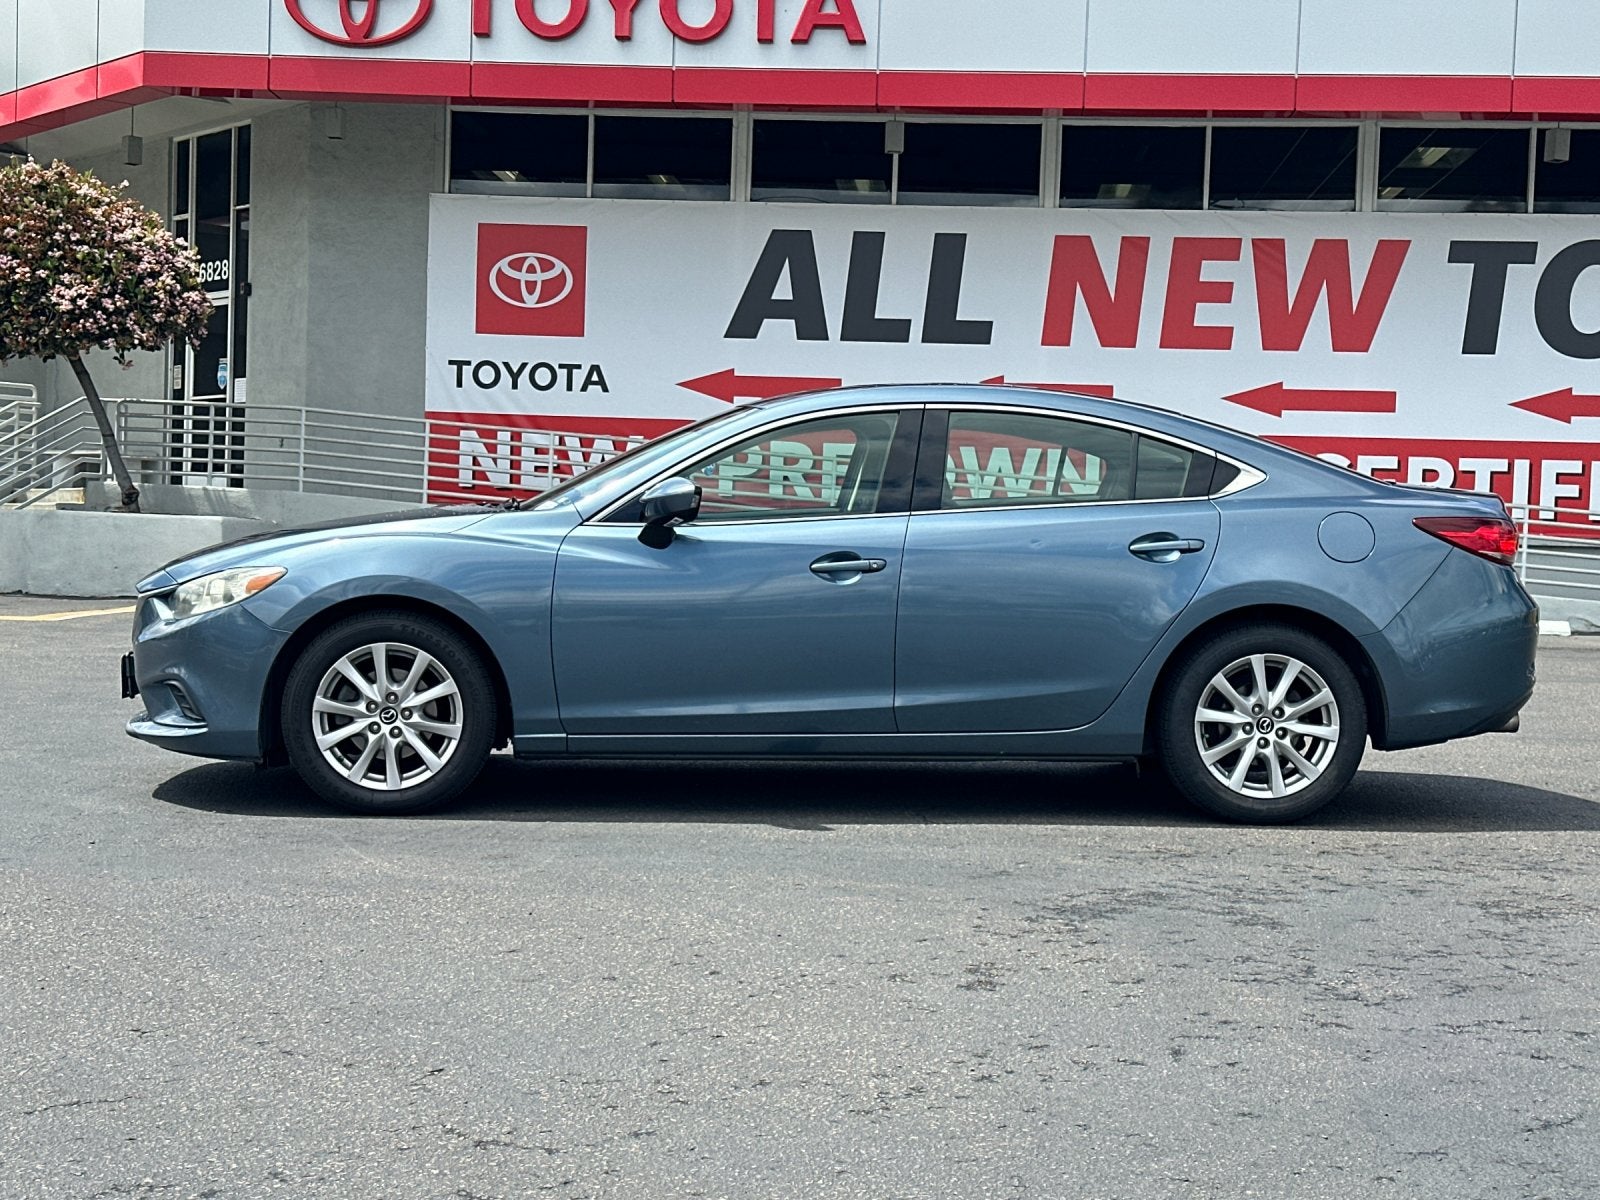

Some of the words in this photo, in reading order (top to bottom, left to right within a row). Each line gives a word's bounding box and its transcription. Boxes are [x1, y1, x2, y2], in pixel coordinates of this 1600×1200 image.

[200, 259, 229, 282] 6828
[724, 229, 993, 345] ALL
[1041, 234, 1411, 353] NEW
[448, 359, 609, 393] TOYOTA
[458, 429, 645, 490] NEW
